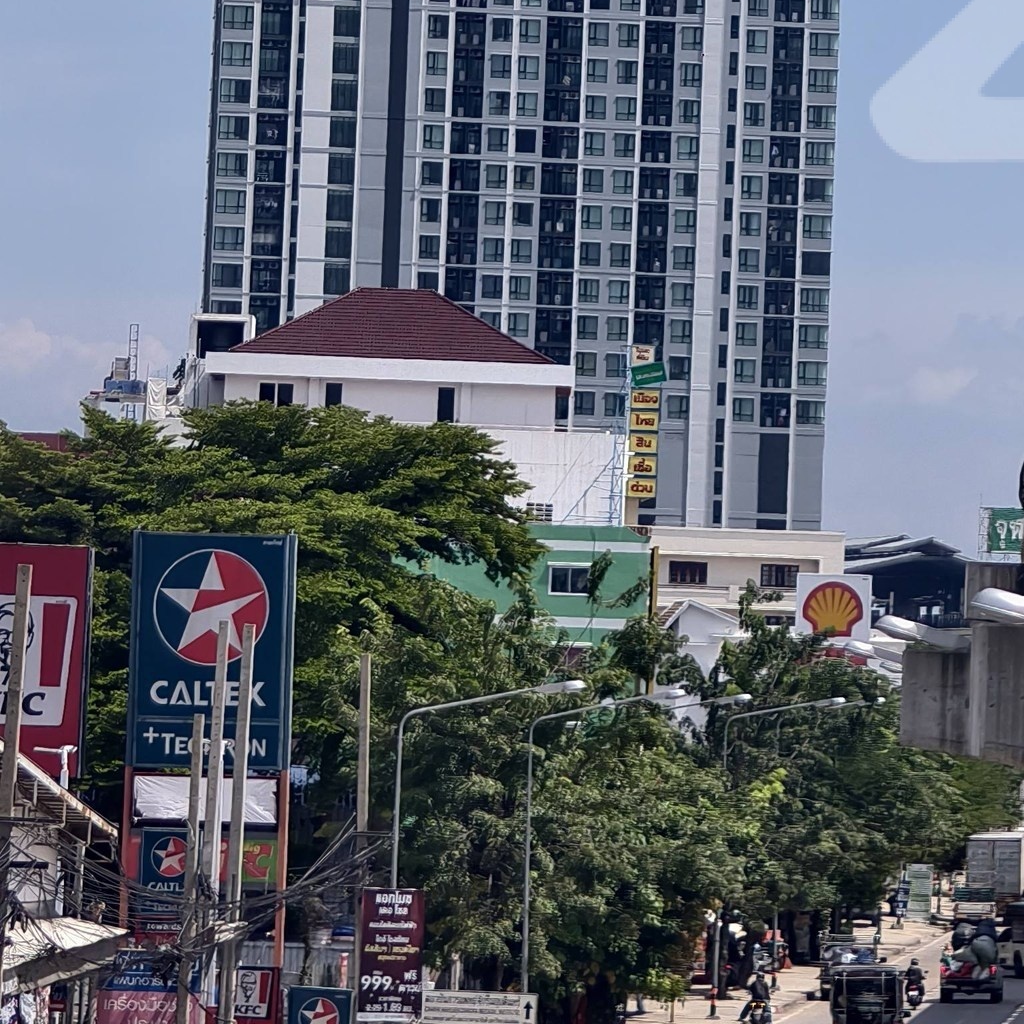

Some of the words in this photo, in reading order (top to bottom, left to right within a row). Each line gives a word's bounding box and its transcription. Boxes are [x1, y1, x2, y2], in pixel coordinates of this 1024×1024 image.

[635, 414, 655, 426] ไทย
[636, 437, 652, 448] สิน
[235, 1005, 262, 1015] KFC
